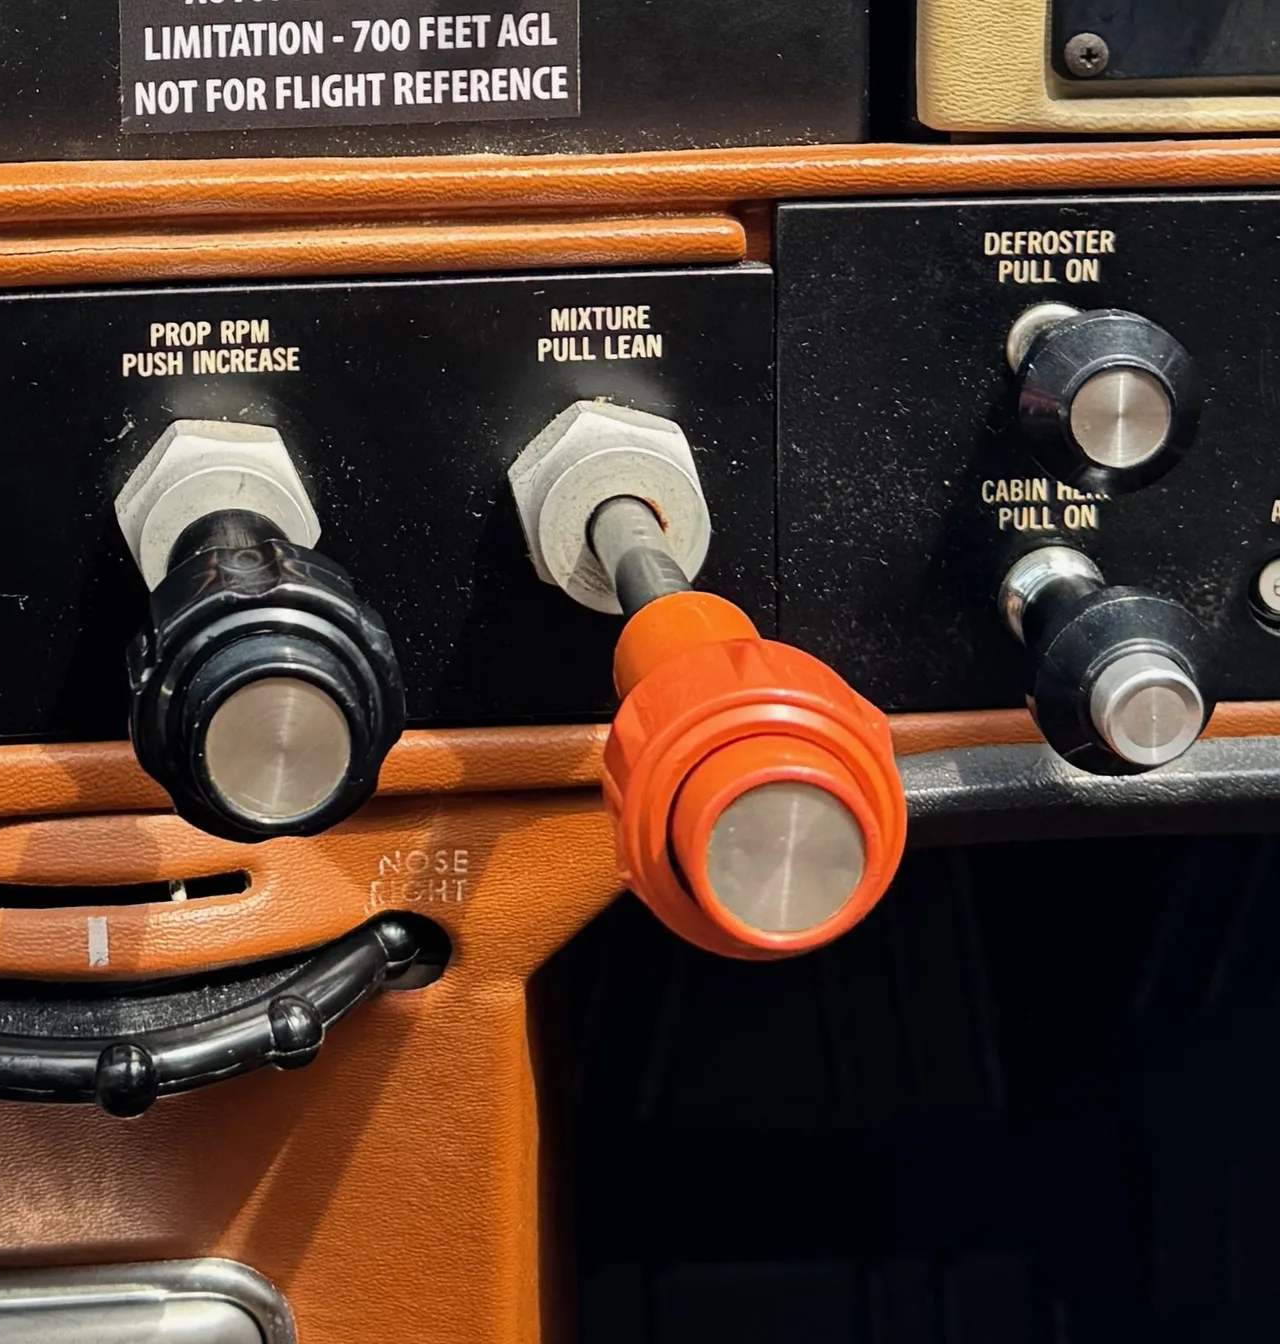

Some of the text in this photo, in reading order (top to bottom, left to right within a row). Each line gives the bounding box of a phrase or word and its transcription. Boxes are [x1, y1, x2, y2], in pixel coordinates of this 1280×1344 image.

[144, 20, 323, 62] LIMITATION
[352, 20, 410, 53] 700
[419, 16, 491, 50] FEET
[496, 13, 557, 47] AGL
[135, 66, 568, 116] NOT FOR FLIGHT REFERENCE
[984, 230, 1115, 256] DEFROSTER
[998, 259, 1099, 283] PULL ON
[550, 305, 650, 332] MIXTURE
[150, 320, 268, 347] PROP RPM
[537, 332, 662, 362] PULL LEAN
[122, 346, 300, 377] PUSH INCREASE
